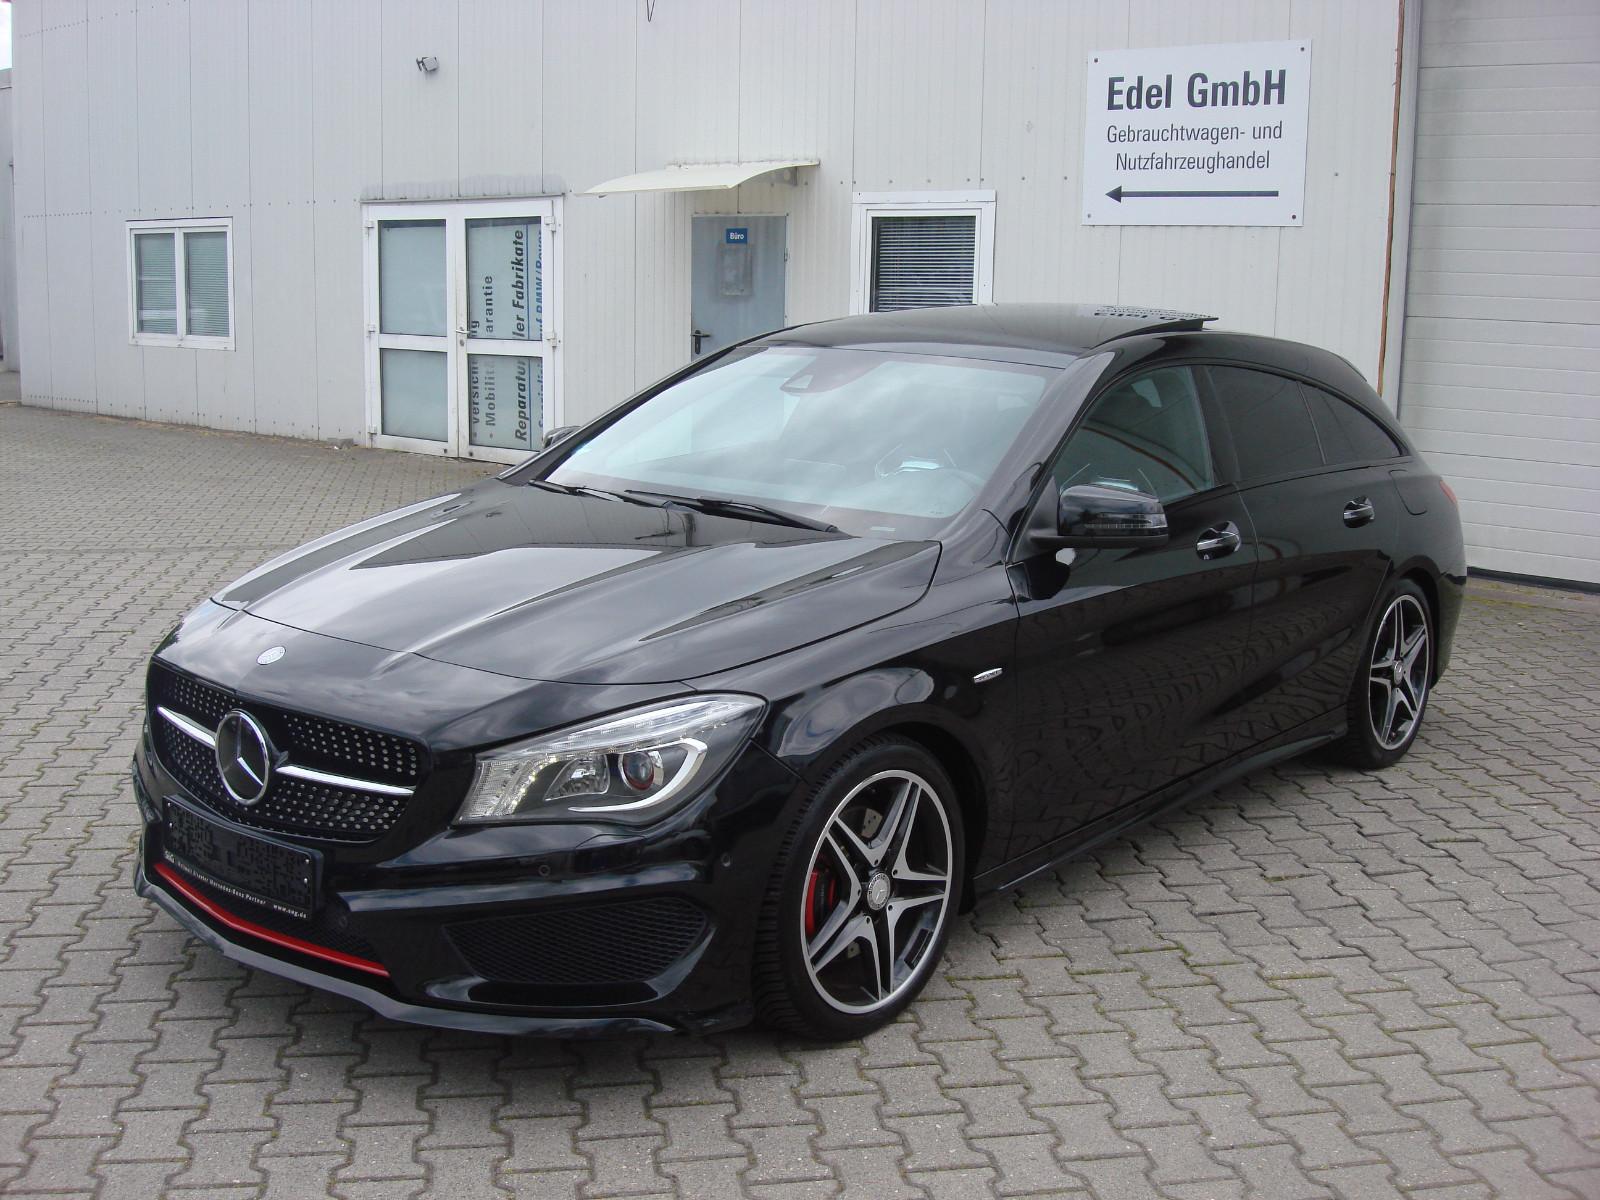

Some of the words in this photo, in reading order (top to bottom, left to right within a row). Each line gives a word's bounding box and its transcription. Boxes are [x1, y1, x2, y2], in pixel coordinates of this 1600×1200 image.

[1107, 74, 1172, 110] Edel
[1187, 69, 1286, 108] GmbH
[1107, 123, 1245, 145] Gebrauchtwagen-
[1252, 121, 1283, 140] und
[1116, 150, 1270, 174] Nutzfahrzeughandel
[511, 230, 525, 309] Fabrikate
